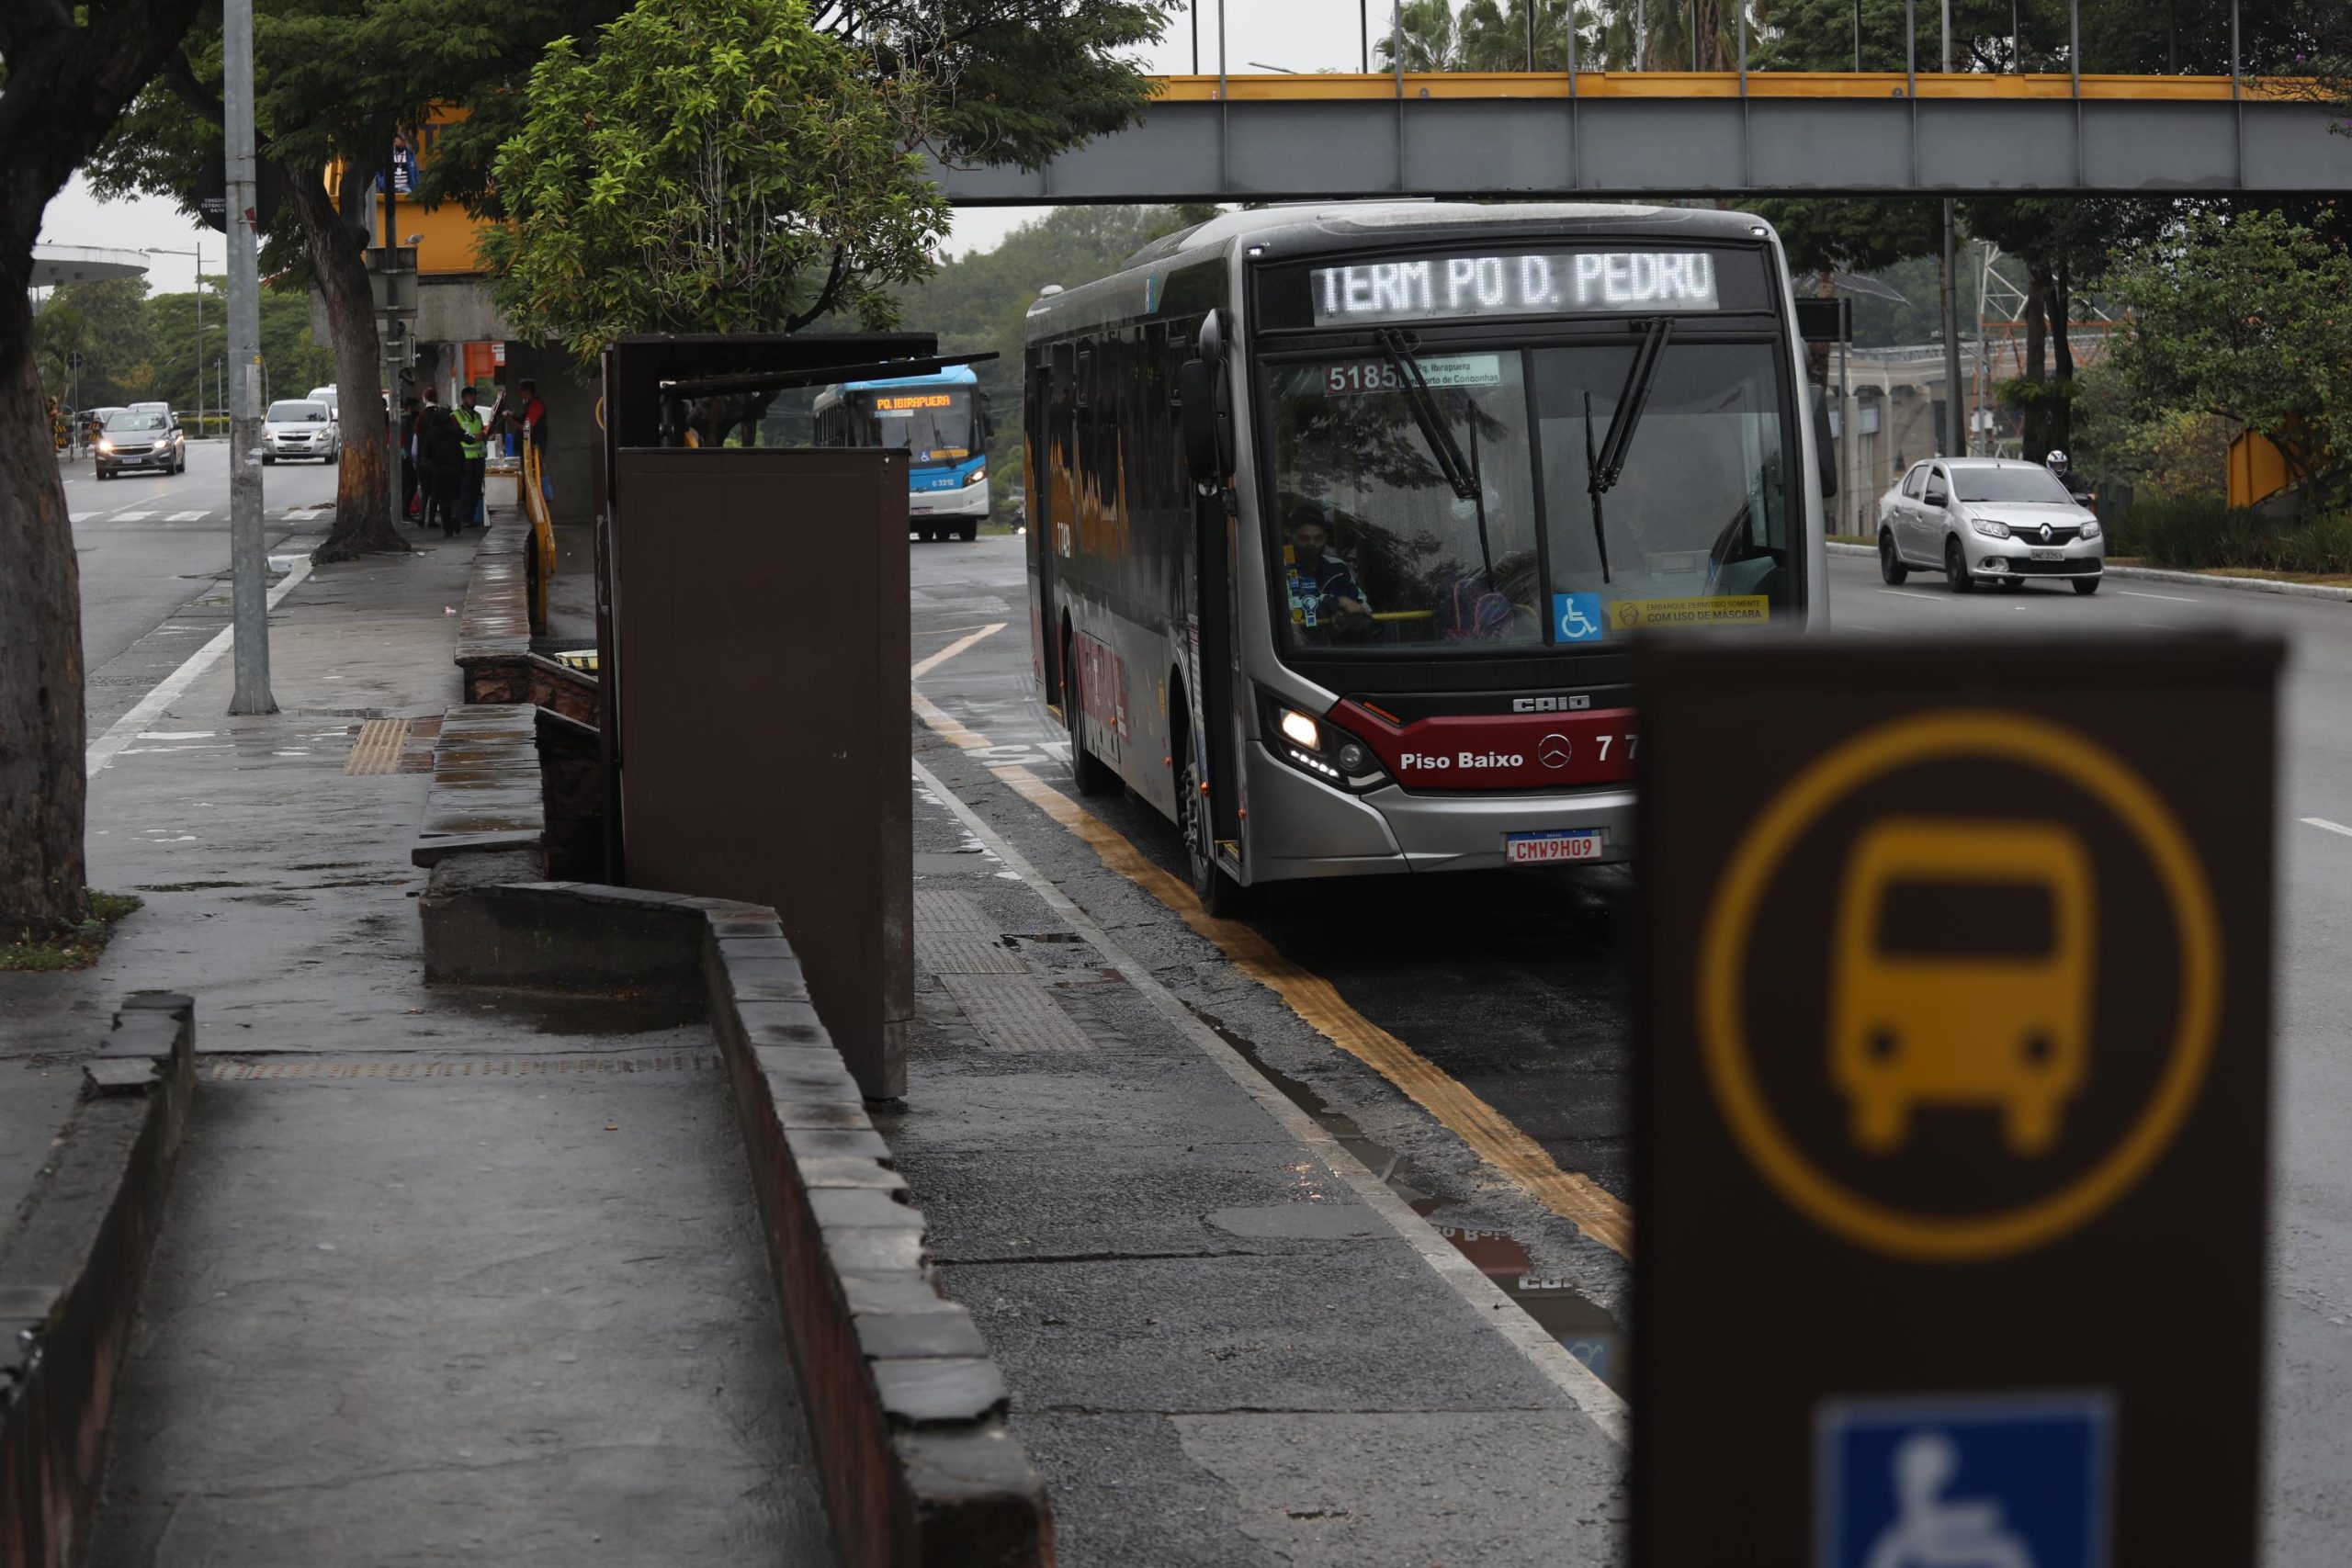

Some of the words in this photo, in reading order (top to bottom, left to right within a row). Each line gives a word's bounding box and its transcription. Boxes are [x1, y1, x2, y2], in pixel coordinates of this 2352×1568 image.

[1521, 254, 1559, 305] D.
[1574, 253, 1711, 302] PEDRO
[1329, 364, 1398, 391] 5185
[1431, 363, 1471, 373] Ibirapuera
[1442, 376, 1453, 384] de
[1645, 603, 1686, 611] EMBARQUE
[1687, 601, 1725, 609] PERMITIDO
[1727, 600, 1760, 608] SOMENTE
[1646, 613, 1671, 623] COM
[1674, 612, 1695, 621] USO
[1697, 611, 1712, 620] DE
[1713, 608, 1761, 620] MÁSCARA
[1512, 694, 1590, 713] CAIO
[1400, 753, 1451, 770] Piso
[1458, 751, 1523, 768] Baixo
[1517, 839, 1592, 860] CMW9H09
